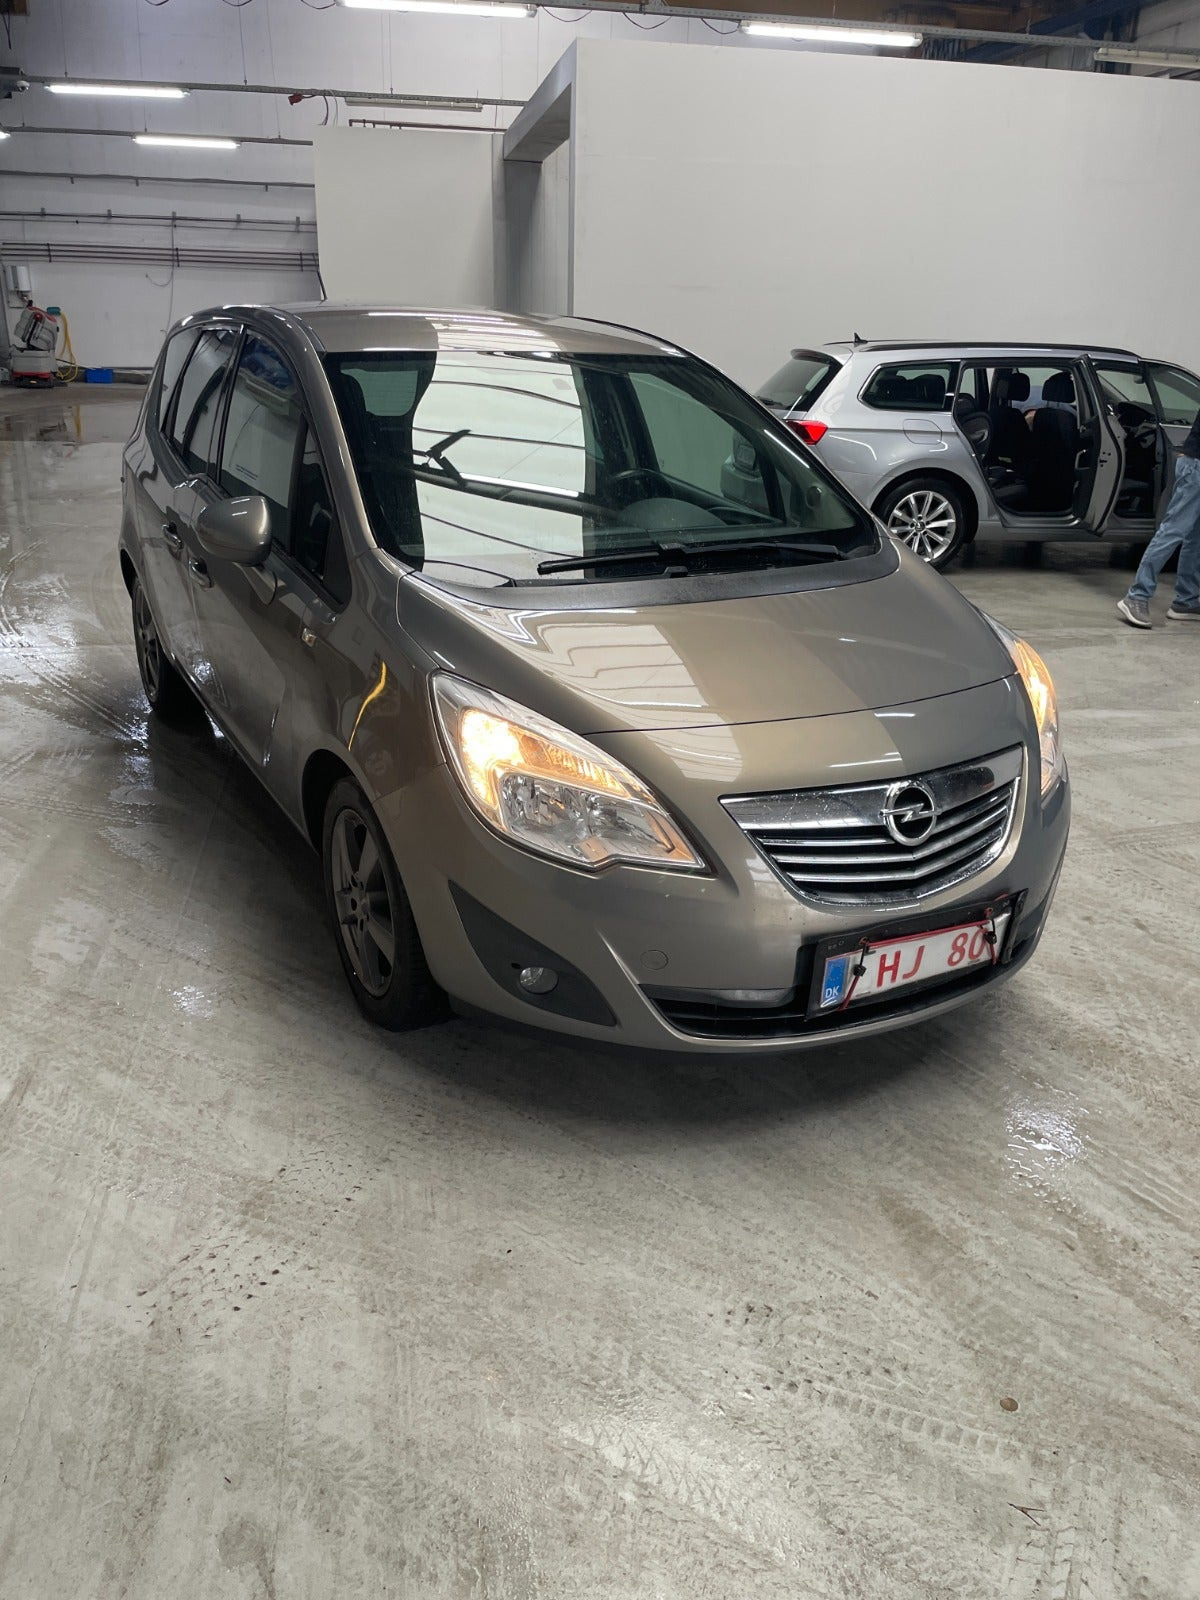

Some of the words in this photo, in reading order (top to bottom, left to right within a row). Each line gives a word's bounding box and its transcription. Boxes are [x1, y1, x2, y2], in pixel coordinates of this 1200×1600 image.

[876, 945, 926, 988] HJ
[947, 928, 987, 967] 80
[825, 985, 840, 999] DK
